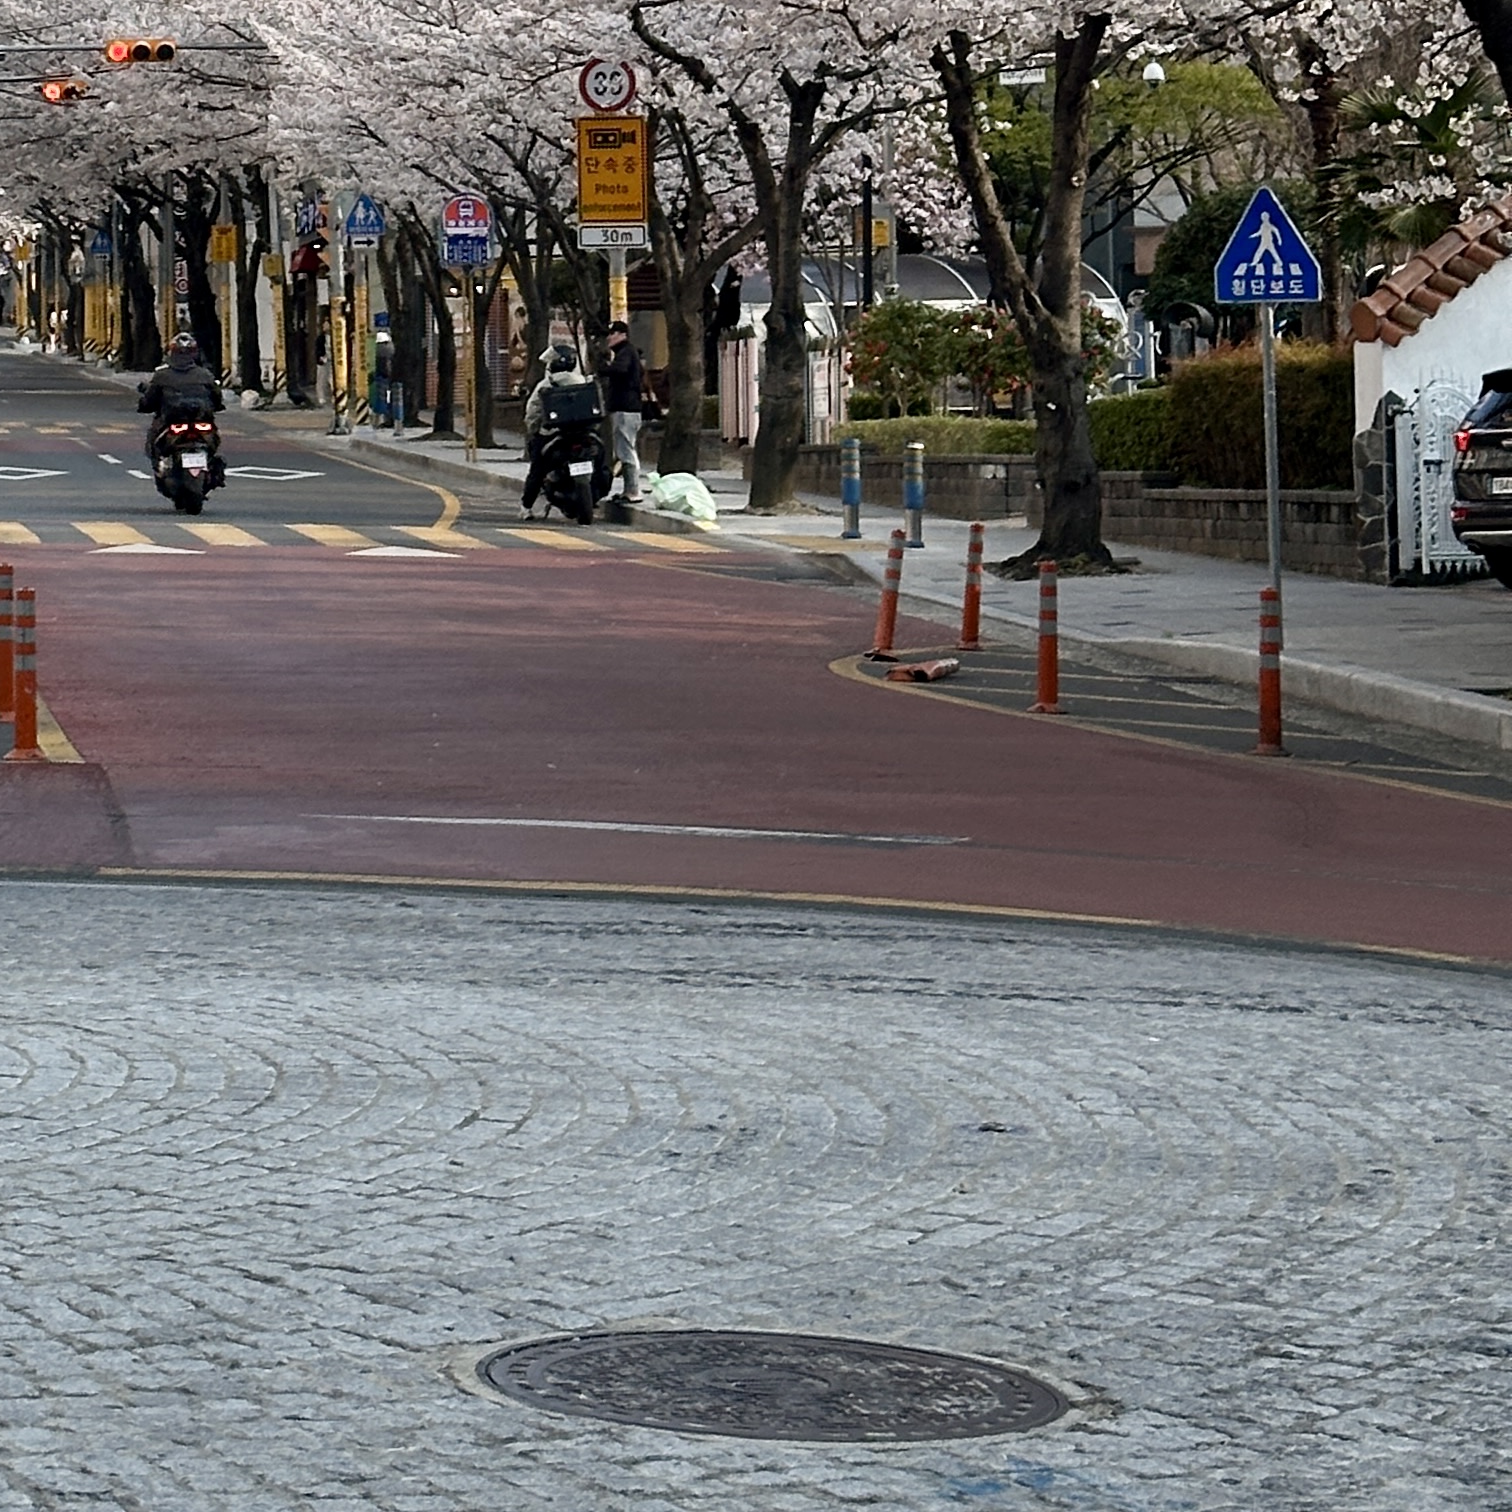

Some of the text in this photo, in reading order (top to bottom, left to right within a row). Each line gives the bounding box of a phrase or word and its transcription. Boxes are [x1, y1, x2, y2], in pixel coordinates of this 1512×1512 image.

[584, 155, 639, 175] 단속중
[594, 183, 629, 195] Photo
[601, 229, 633, 243] 30m
[1231, 278, 1305, 296] 횡단보도
